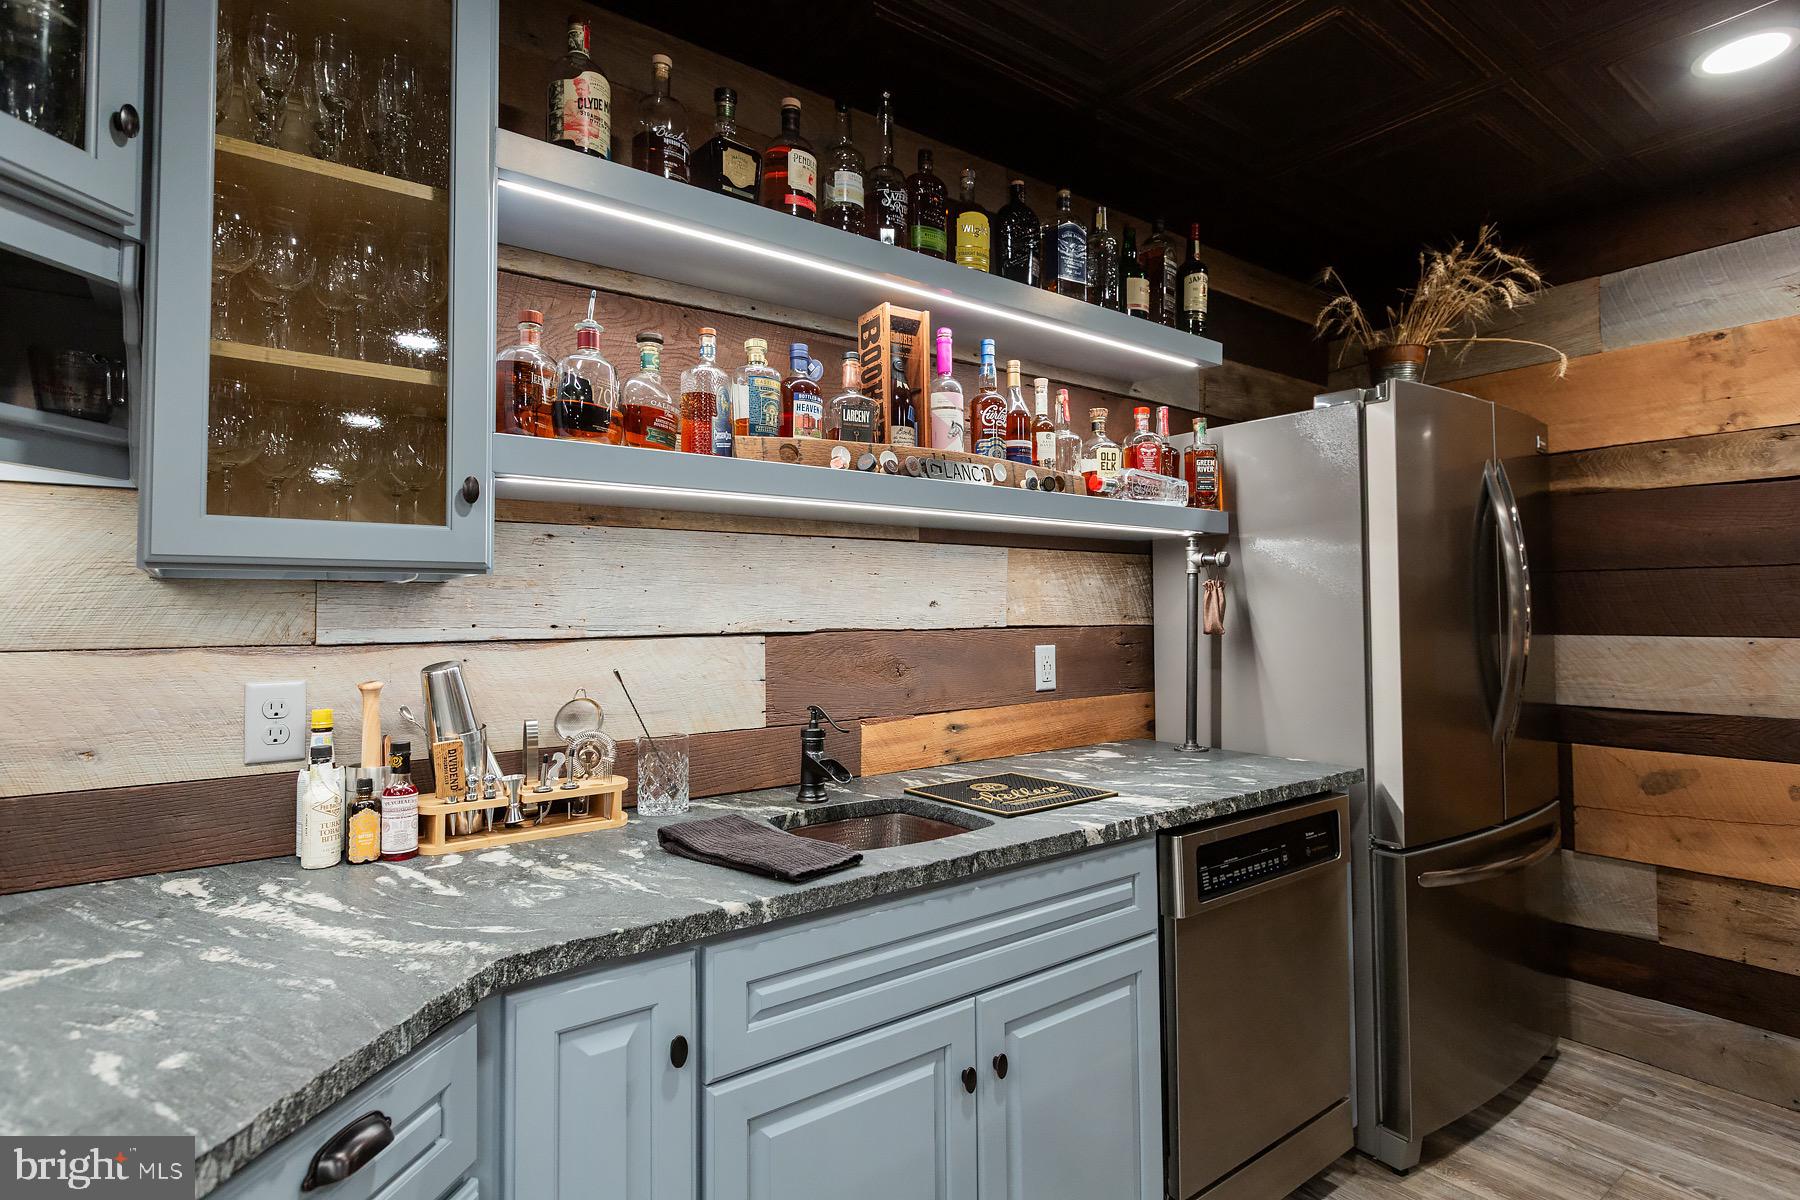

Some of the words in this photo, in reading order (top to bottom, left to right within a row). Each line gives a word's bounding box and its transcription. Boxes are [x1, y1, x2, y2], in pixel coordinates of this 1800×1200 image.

[577, 97, 603, 111] CLYDE
[796, 403, 820, 414] HEAVEN
[842, 408, 871, 424] LARCENY
[1100, 451, 1117, 462] OLD
[1100, 461, 1117, 472] ELK
[1196, 459, 1215, 467] GREEN
